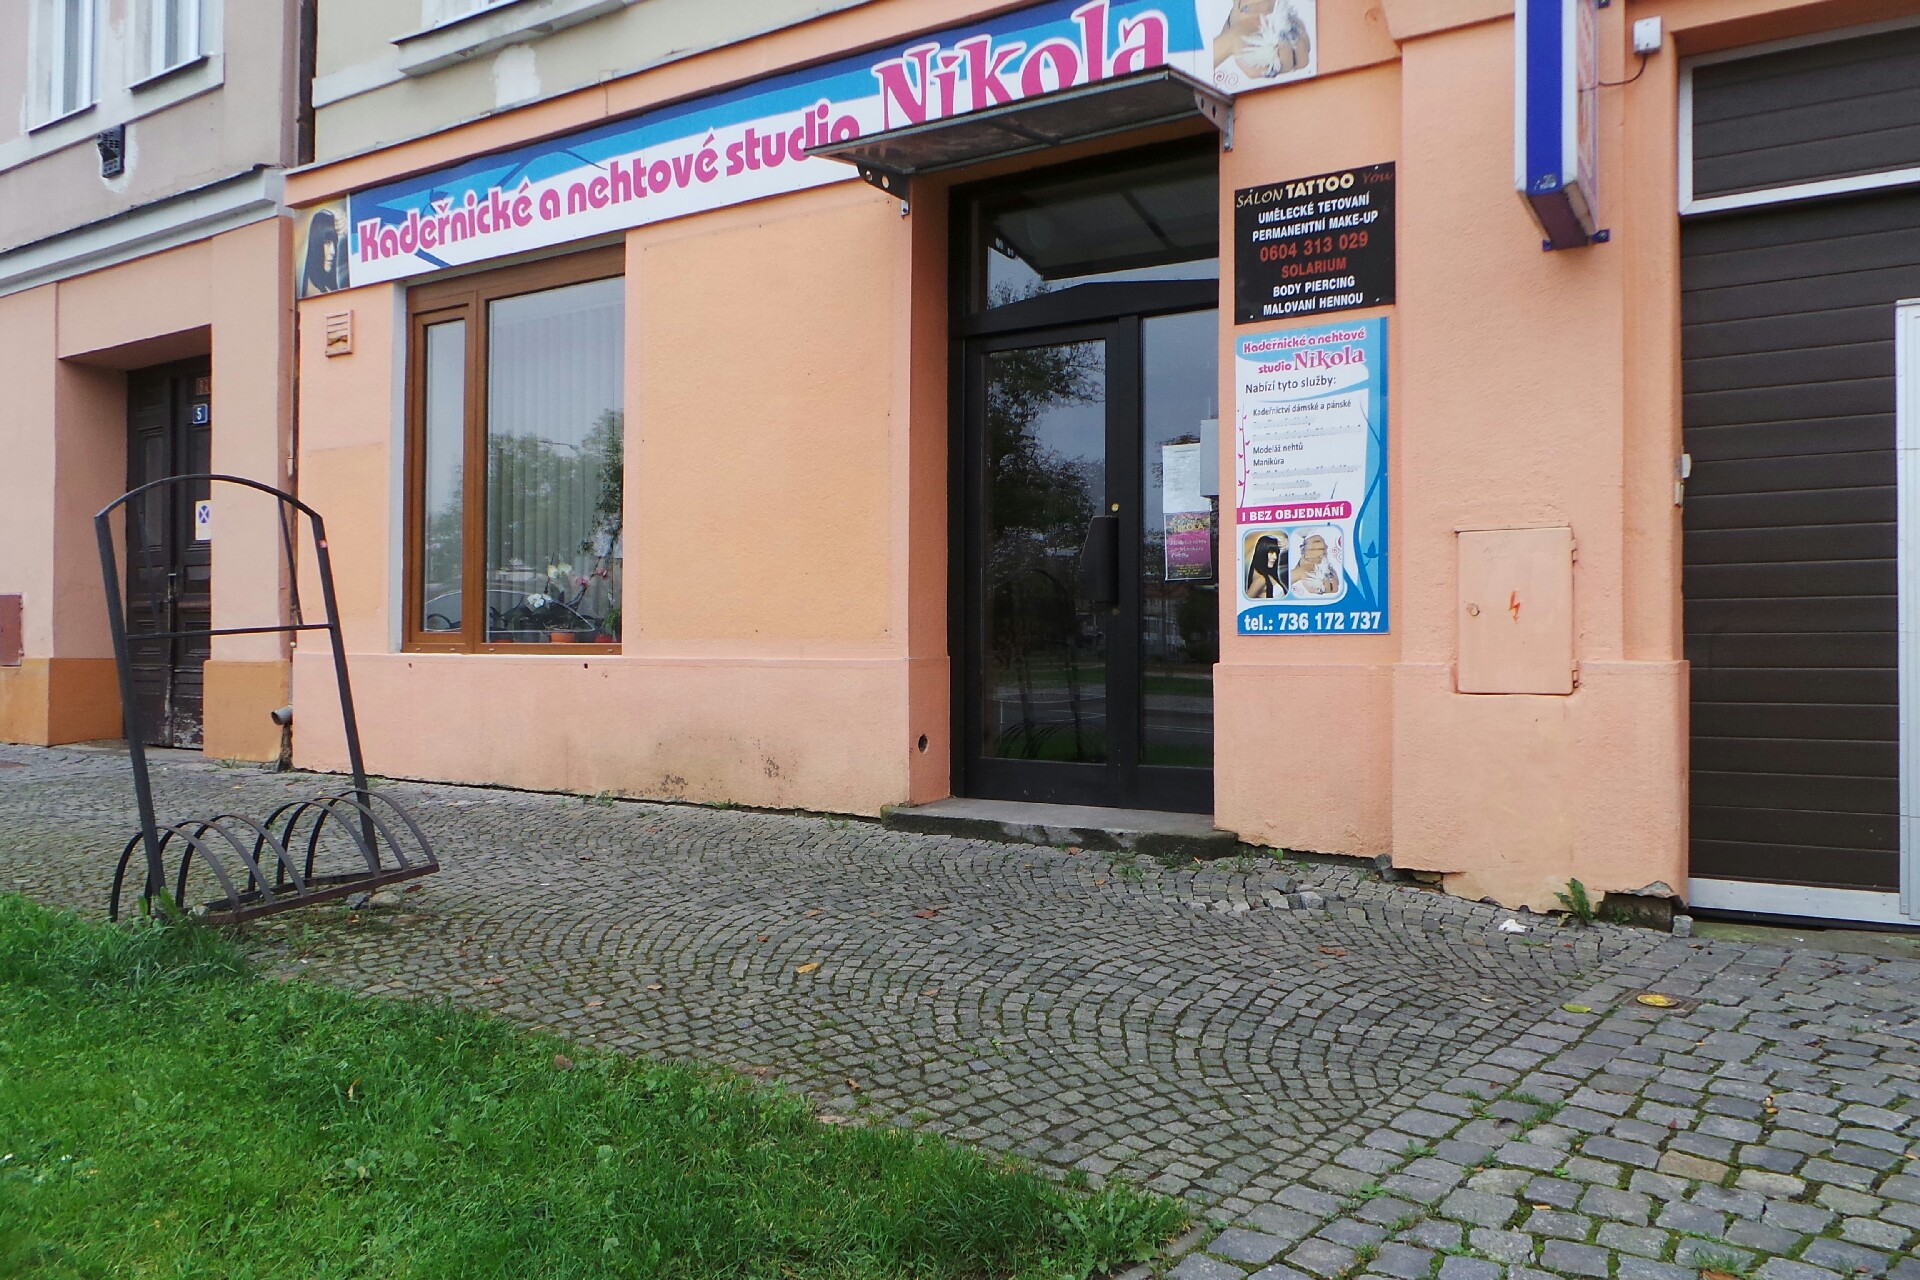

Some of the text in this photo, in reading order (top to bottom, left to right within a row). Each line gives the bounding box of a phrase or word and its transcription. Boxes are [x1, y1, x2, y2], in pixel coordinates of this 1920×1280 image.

[360, 4, 1167, 263] Kadeřnické a nehtové studio Nikola
[1285, 172, 1355, 200] TATTOO
[1258, 201, 1315, 225] UMĚLECKÉ
[1252, 210, 1379, 243] PERMANENTNÍ MAKE-UP
[1259, 231, 1369, 263] 0604 313 029
[1281, 257, 1347, 279] SOLARIUM
[1273, 275, 1355, 298] BODY PIERCING
[1319, 292, 1364, 309] HENNOU
[1243, 327, 1366, 354] Kadeřnické a nehtové
[1258, 346, 1365, 374] studio Nikola
[1245, 375, 1337, 394] Nabízí tyto služby:
[197, 407, 202, 421] 5
[1292, 401, 1319, 413] dámské
[1326, 399, 1352, 412] pánské
[1252, 456, 1285, 467] Manikúra
[1250, 508, 1273, 521] BEZ
[1275, 502, 1345, 520] OBJEDNÁNÍ
[1244, 611, 1381, 631] tel.: 736 172 737
